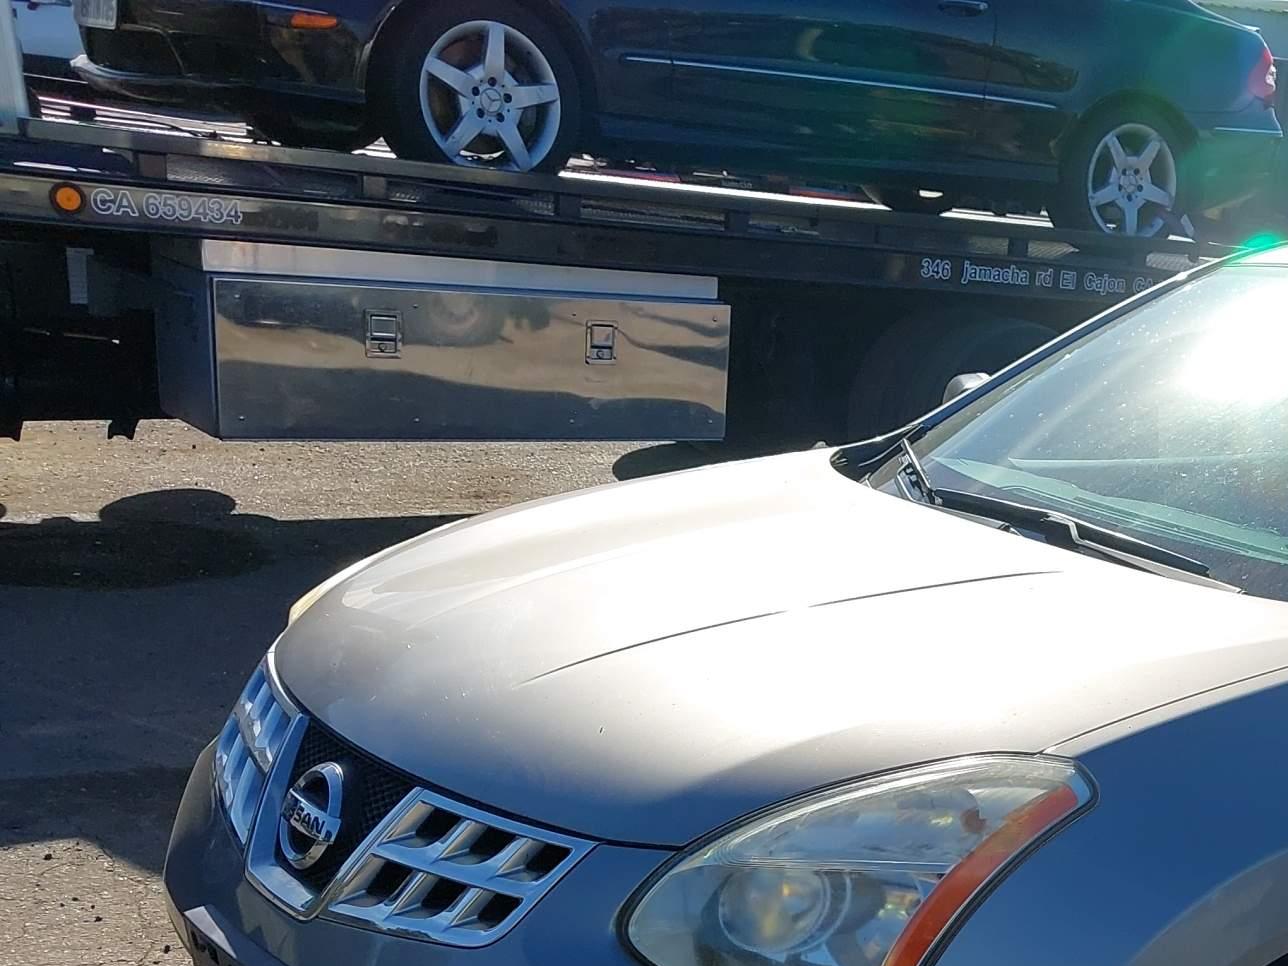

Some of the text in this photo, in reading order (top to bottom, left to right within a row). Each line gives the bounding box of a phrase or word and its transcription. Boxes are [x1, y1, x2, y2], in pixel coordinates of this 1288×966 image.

[91, 188, 243, 224] CA 659434
[920, 258, 952, 280] 346
[961, 261, 1030, 285] jamacha
[1035, 268, 1054, 287] rd
[1059, 270, 1077, 290] El
[1083, 272, 1126, 295] Cajon
[283, 796, 327, 836] SSAN
